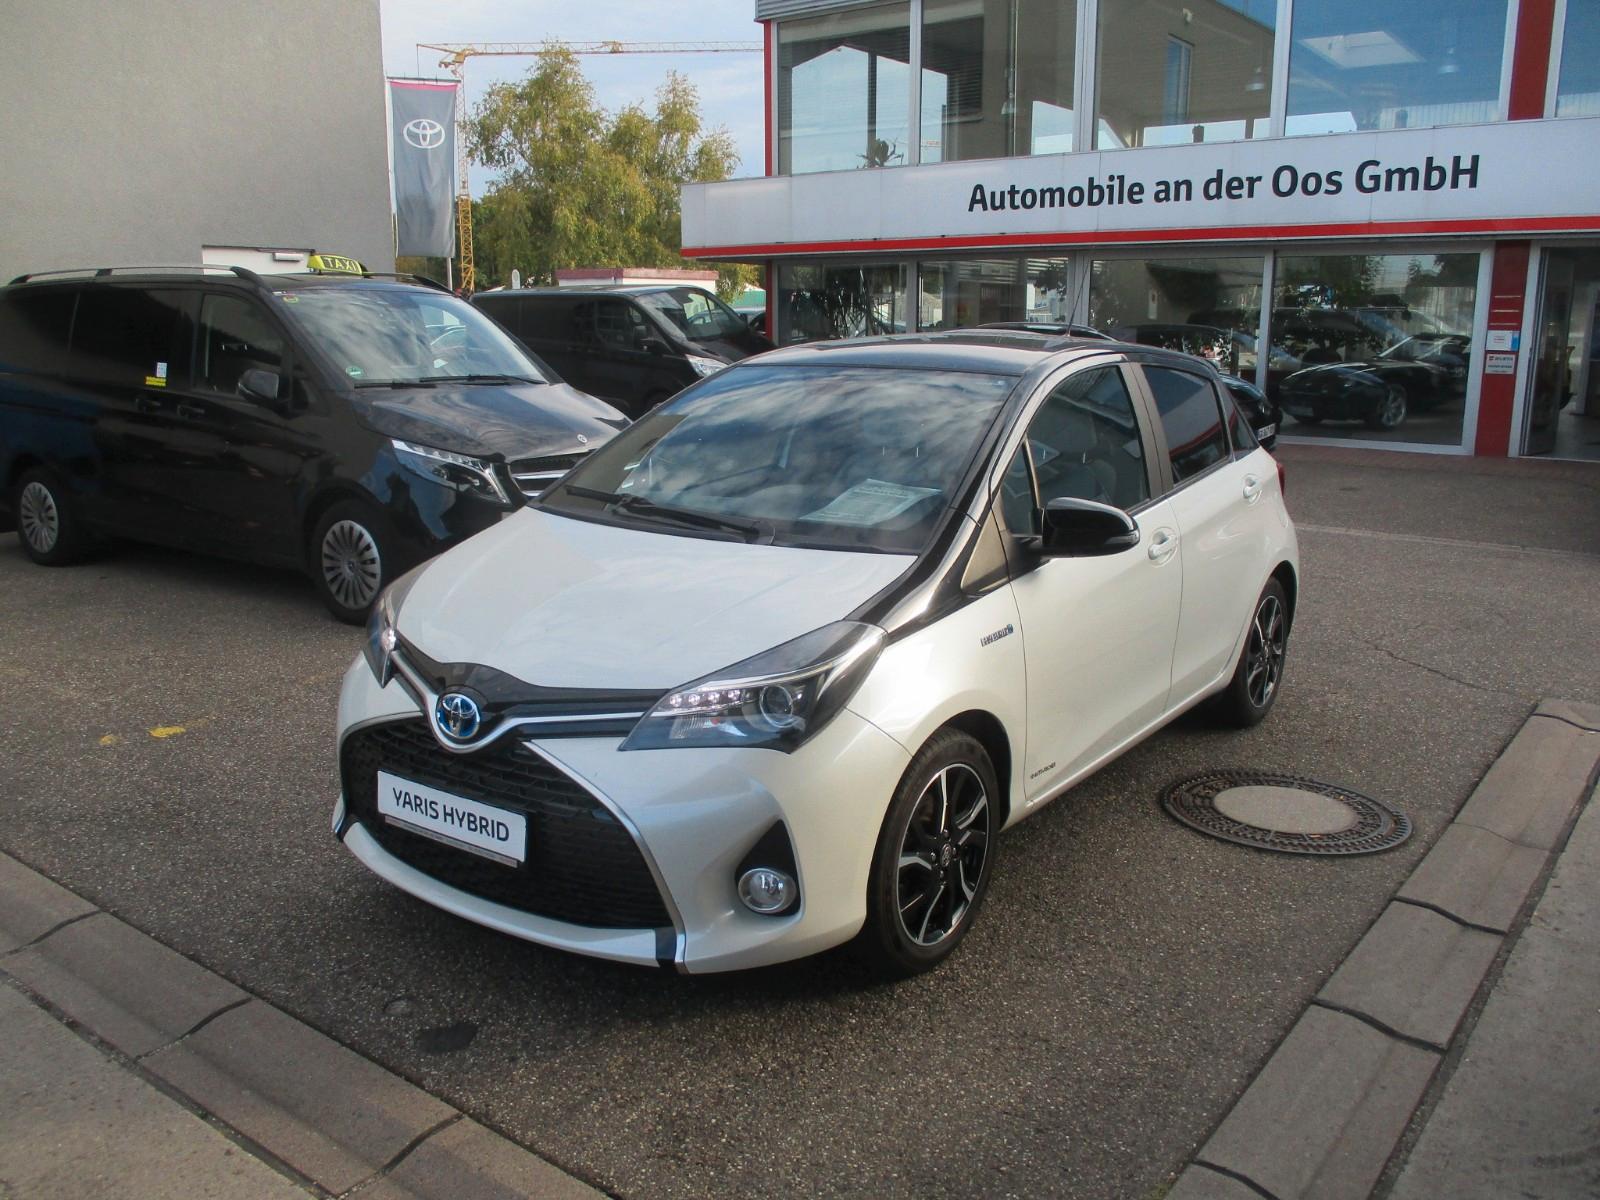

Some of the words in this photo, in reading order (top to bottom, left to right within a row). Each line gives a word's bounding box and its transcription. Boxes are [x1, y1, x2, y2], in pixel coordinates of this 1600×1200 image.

[967, 174, 1145, 213] Automobile
[1153, 179, 1193, 204] an
[1202, 168, 1263, 201] der
[1271, 164, 1343, 198] Oos
[1355, 154, 1480, 194] GmbH
[323, 256, 357, 271] TAXI
[392, 787, 440, 820] YARIS
[442, 804, 510, 842] HYBRID
